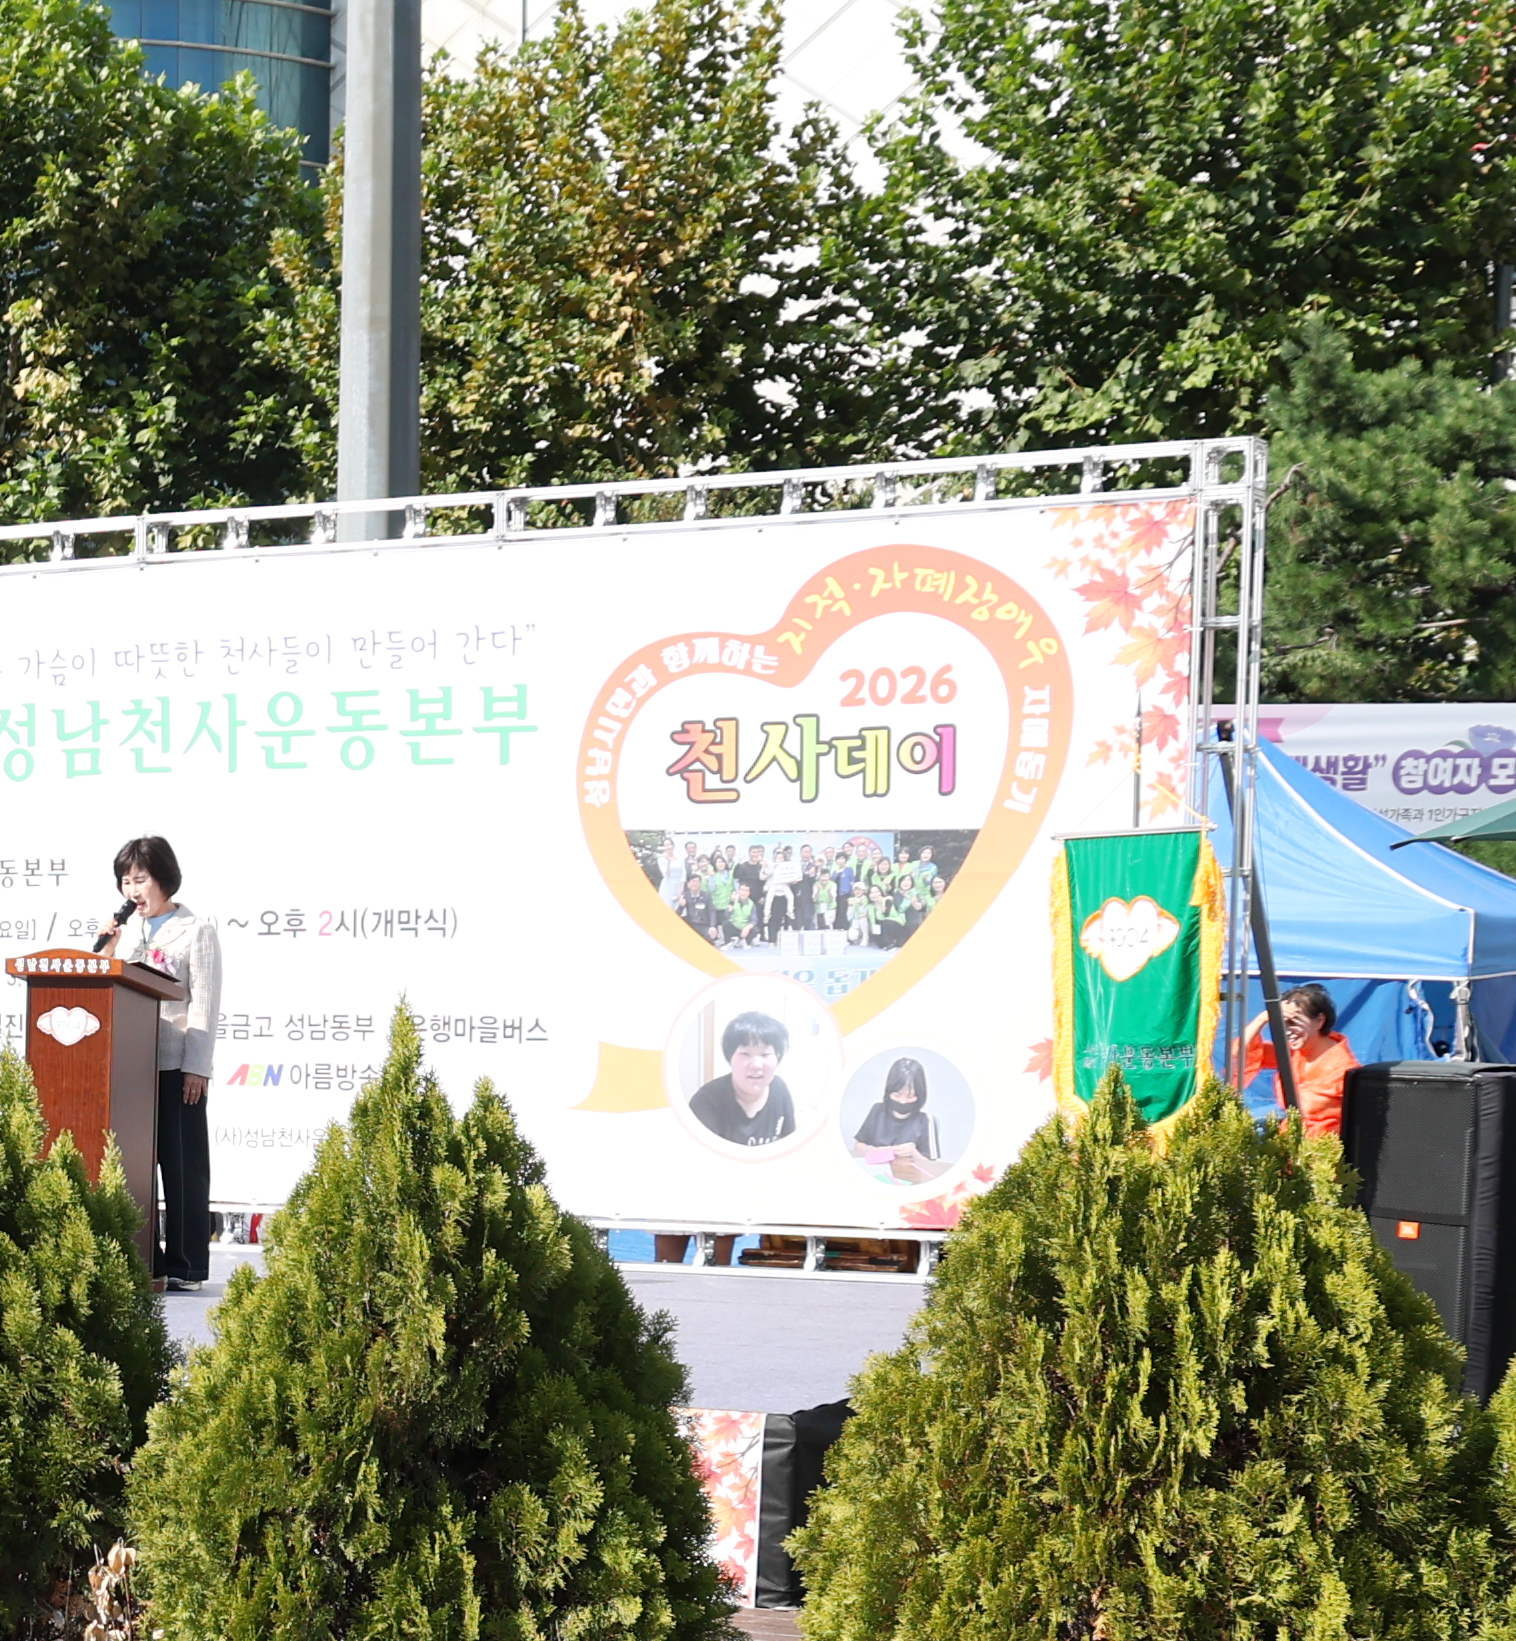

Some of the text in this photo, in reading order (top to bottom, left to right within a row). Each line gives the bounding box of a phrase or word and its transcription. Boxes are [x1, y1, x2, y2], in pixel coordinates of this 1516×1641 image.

[18, 647, 96, 687] 가슴이
[113, 638, 204, 680] 따뜻한
[219, 634, 332, 675] 천사들이
[351, 628, 437, 670] 만들어
[661, 637, 779, 675] 함께하는
[839, 664, 958, 708] 2026
[583, 668, 658, 808] 성남시민과
[667, 713, 958, 804] 천사데이
[1004, 684, 1052, 813] 자매돕기
[1400, 756, 1483, 789] 참여자
[257, 908, 308, 938] 오후
[318, 906, 458, 939] 2시(개막식)
[285, 1014, 376, 1041] 성남동부
[226, 1063, 284, 1087] ABN
